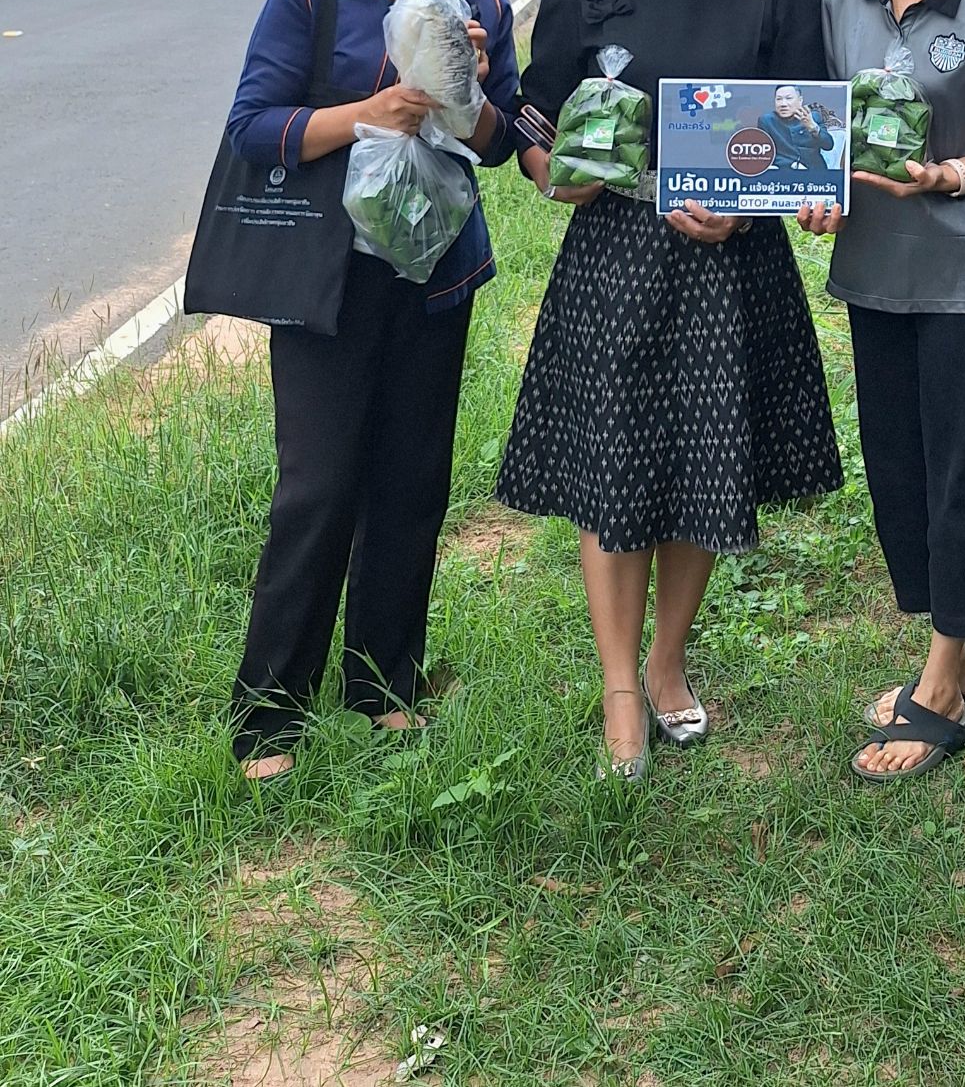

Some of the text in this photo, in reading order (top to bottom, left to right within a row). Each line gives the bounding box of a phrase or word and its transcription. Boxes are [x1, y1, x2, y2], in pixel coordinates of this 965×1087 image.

[731, 143, 772, 155] OTOP
[668, 172, 837, 194] ปลัด มท. แจ้งผู้ว่าฯ 76 จังหวัด
[740, 199, 769, 208] OTOP
